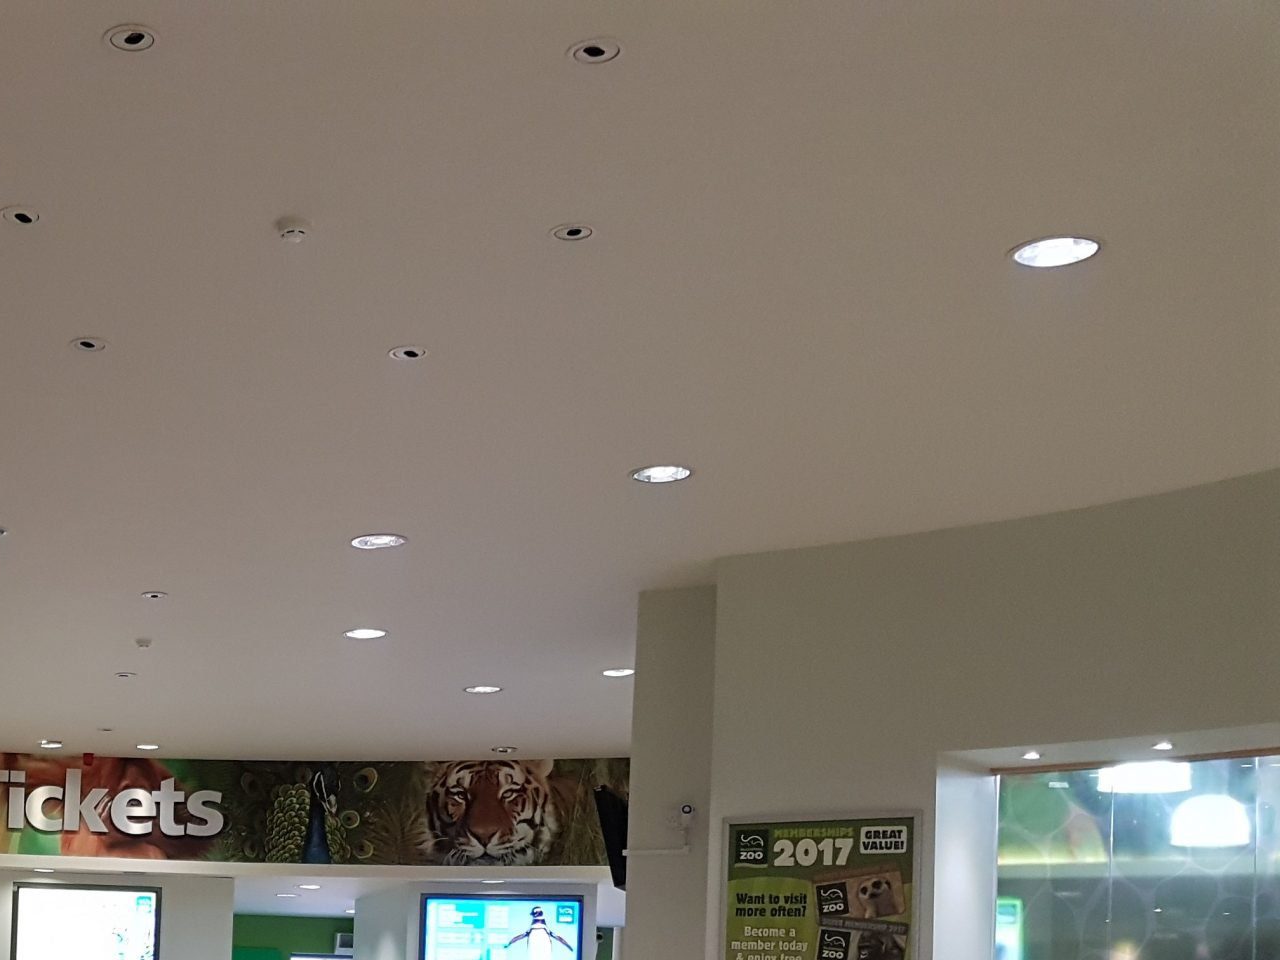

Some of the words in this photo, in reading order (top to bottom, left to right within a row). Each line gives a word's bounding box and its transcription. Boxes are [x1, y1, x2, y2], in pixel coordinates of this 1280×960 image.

[773, 827, 855, 839] MEMBERSHIPS
[864, 829, 903, 840] GREAT
[862, 840, 904, 851] VALUE!
[739, 851, 764, 860] ZOO
[773, 838, 854, 867] 2017
[736, 892, 765, 905] Want
[768, 893, 780, 905] to
[783, 893, 807, 905] visit
[735, 907, 766, 917] more
[770, 905, 807, 917] often?
[822, 903, 844, 913] ZOO
[744, 926, 786, 937] Become
[789, 928, 796, 937] a
[731, 940, 776, 951] member
[778, 940, 808, 952] today
[821, 950, 844, 960] ZOO
